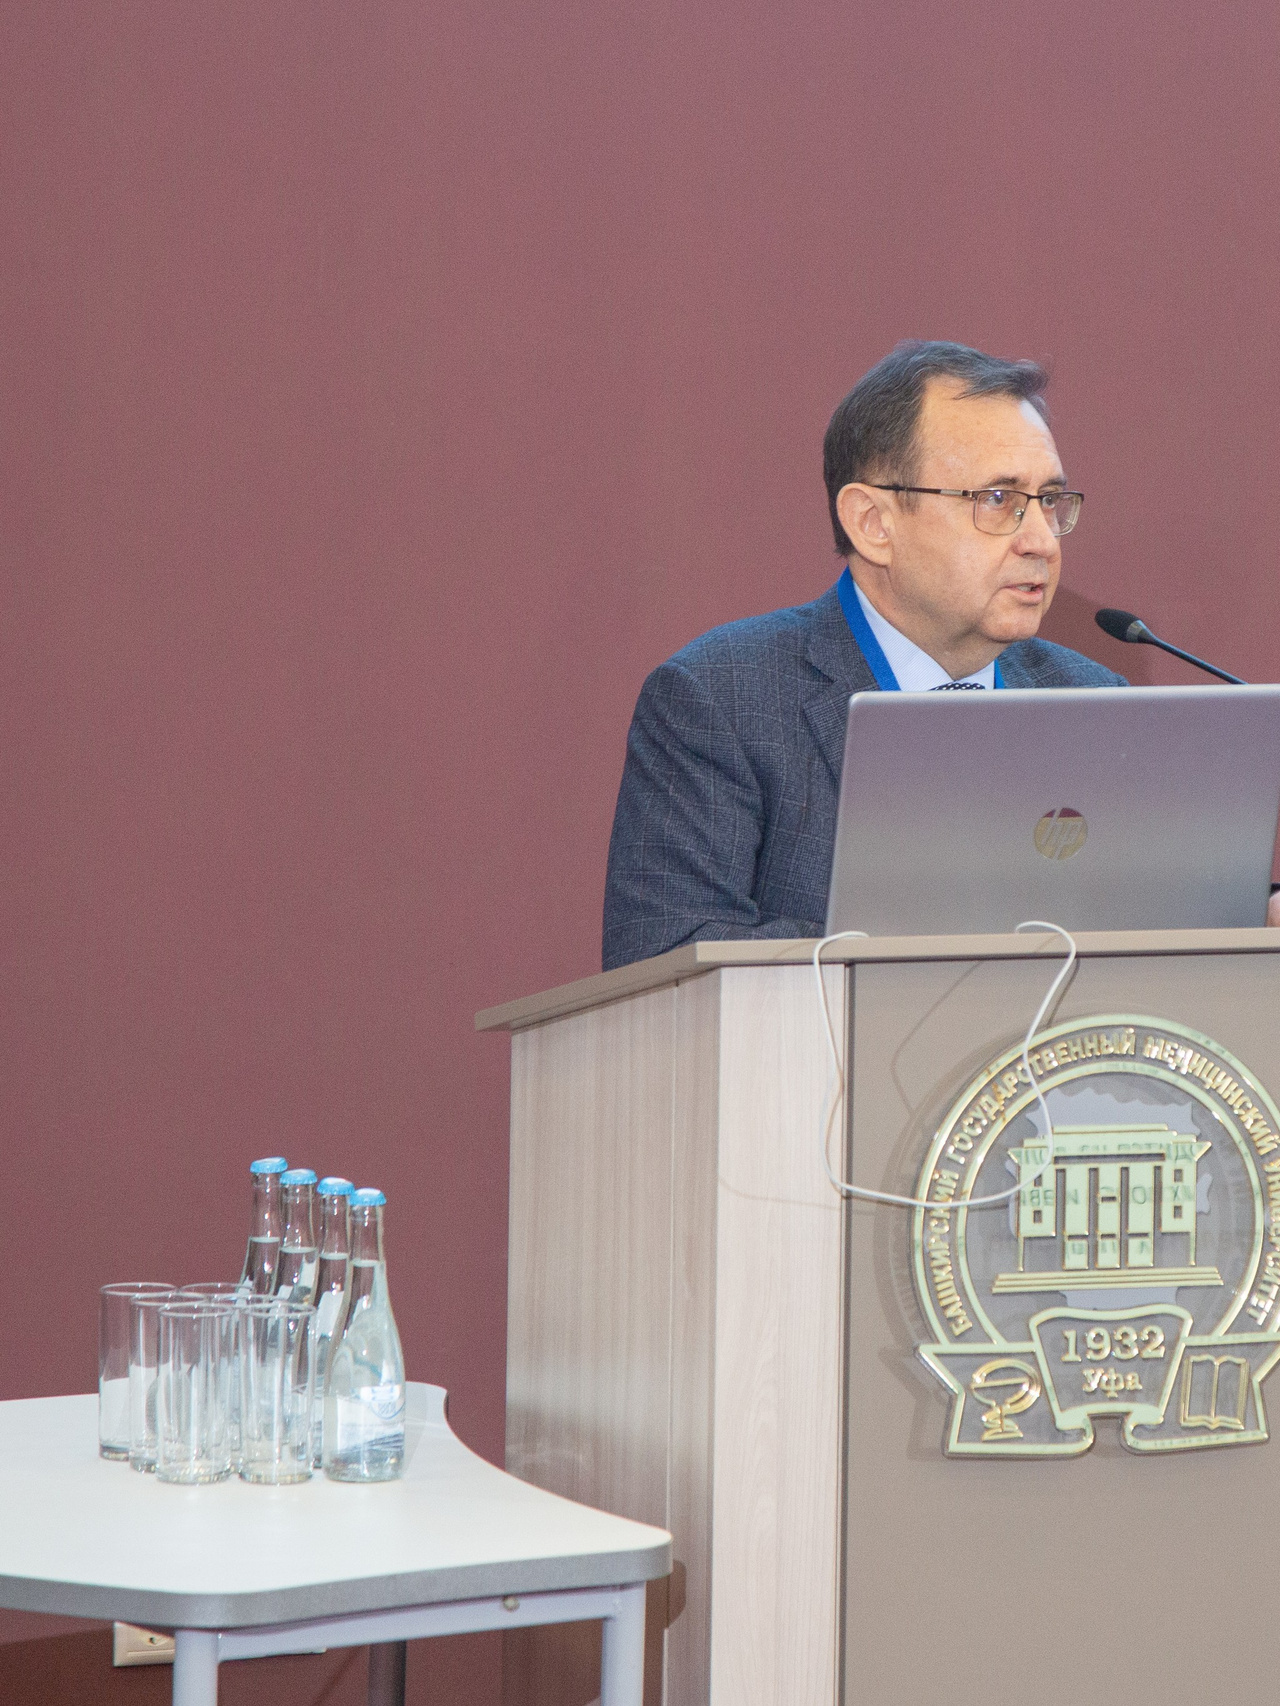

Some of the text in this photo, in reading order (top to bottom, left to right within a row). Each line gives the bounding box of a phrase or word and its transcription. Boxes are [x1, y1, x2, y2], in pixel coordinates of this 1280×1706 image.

[946, 1027, 1136, 1165] ГОСУДАРСТВЕННЫЙ
[928, 1169, 974, 1337] БАШКИРСКИЙ
[1061, 1325, 1166, 1363] 1932
[1082, 1366, 1143, 1398] Уфа
